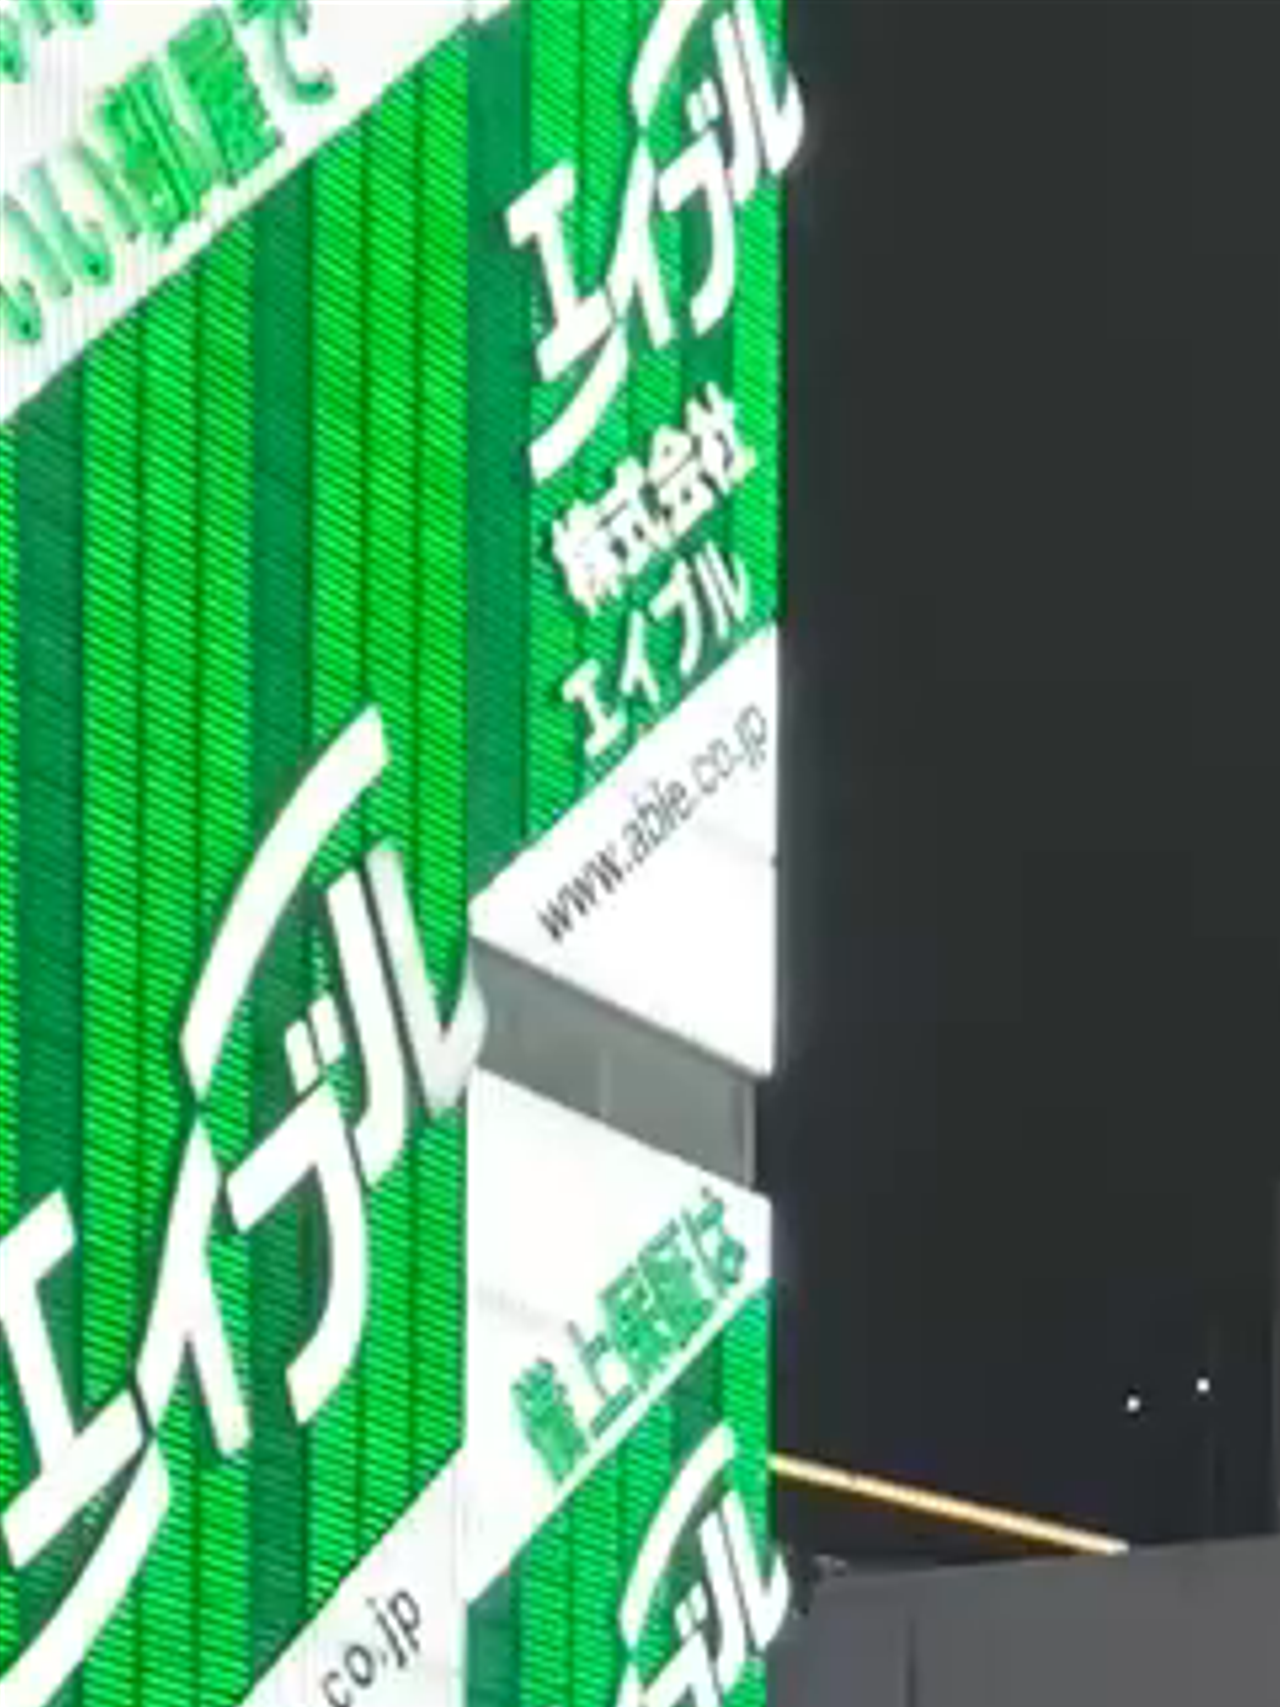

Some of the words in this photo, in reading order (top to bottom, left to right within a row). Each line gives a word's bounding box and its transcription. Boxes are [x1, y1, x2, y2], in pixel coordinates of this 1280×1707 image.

[505, 0, 805, 485] エイブル
[553, 382, 757, 618] 株式会社
[563, 540, 750, 758] エイブル
[536, 702, 768, 945] www.able.co.jp
